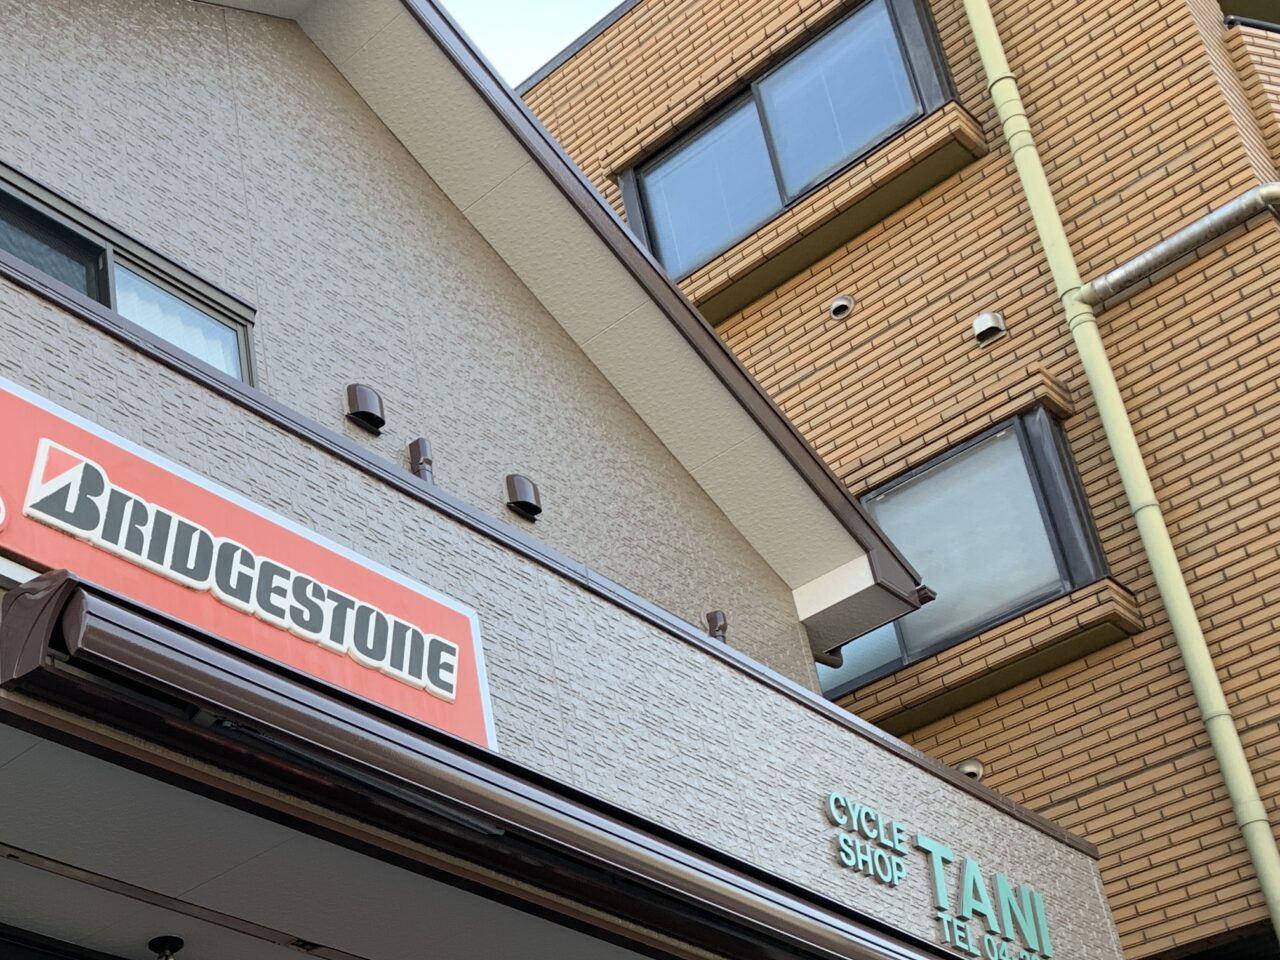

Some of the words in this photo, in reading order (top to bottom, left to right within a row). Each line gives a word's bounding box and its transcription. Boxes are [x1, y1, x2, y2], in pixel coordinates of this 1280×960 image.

[23, 437, 458, 702] BRIDGESTONE
[825, 791, 908, 854] CYCLE
[836, 833, 908, 887] SHOP
[914, 834, 1053, 958] TANI
[935, 912, 980, 957] TEL
